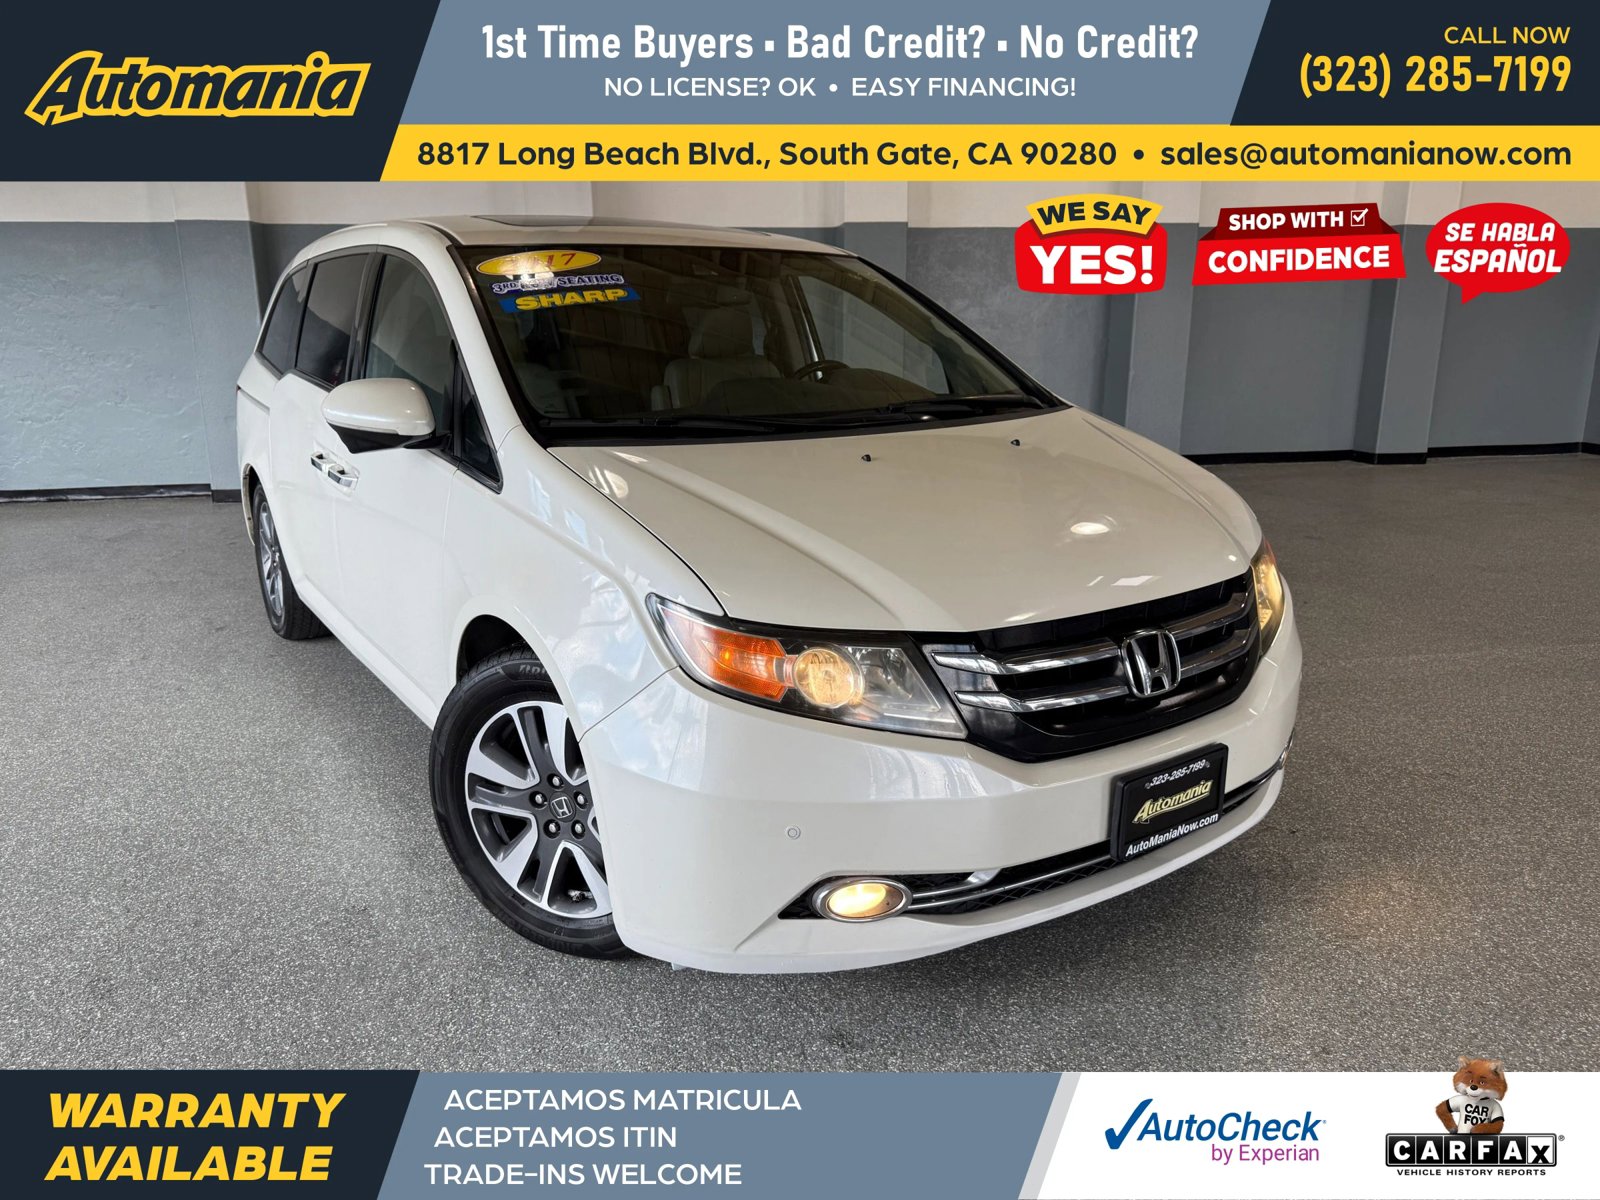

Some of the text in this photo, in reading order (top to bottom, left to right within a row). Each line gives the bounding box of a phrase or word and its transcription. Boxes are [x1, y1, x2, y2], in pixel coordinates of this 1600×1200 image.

[492, 281, 519, 294] 3RD
[557, 274, 624, 287] SEATING
[515, 289, 628, 311] SHARP
[1149, 759, 1206, 787] 323-285-7199
[1132, 780, 1213, 823] Automania
[1125, 813, 1219, 856] AutoManiaNow.com
